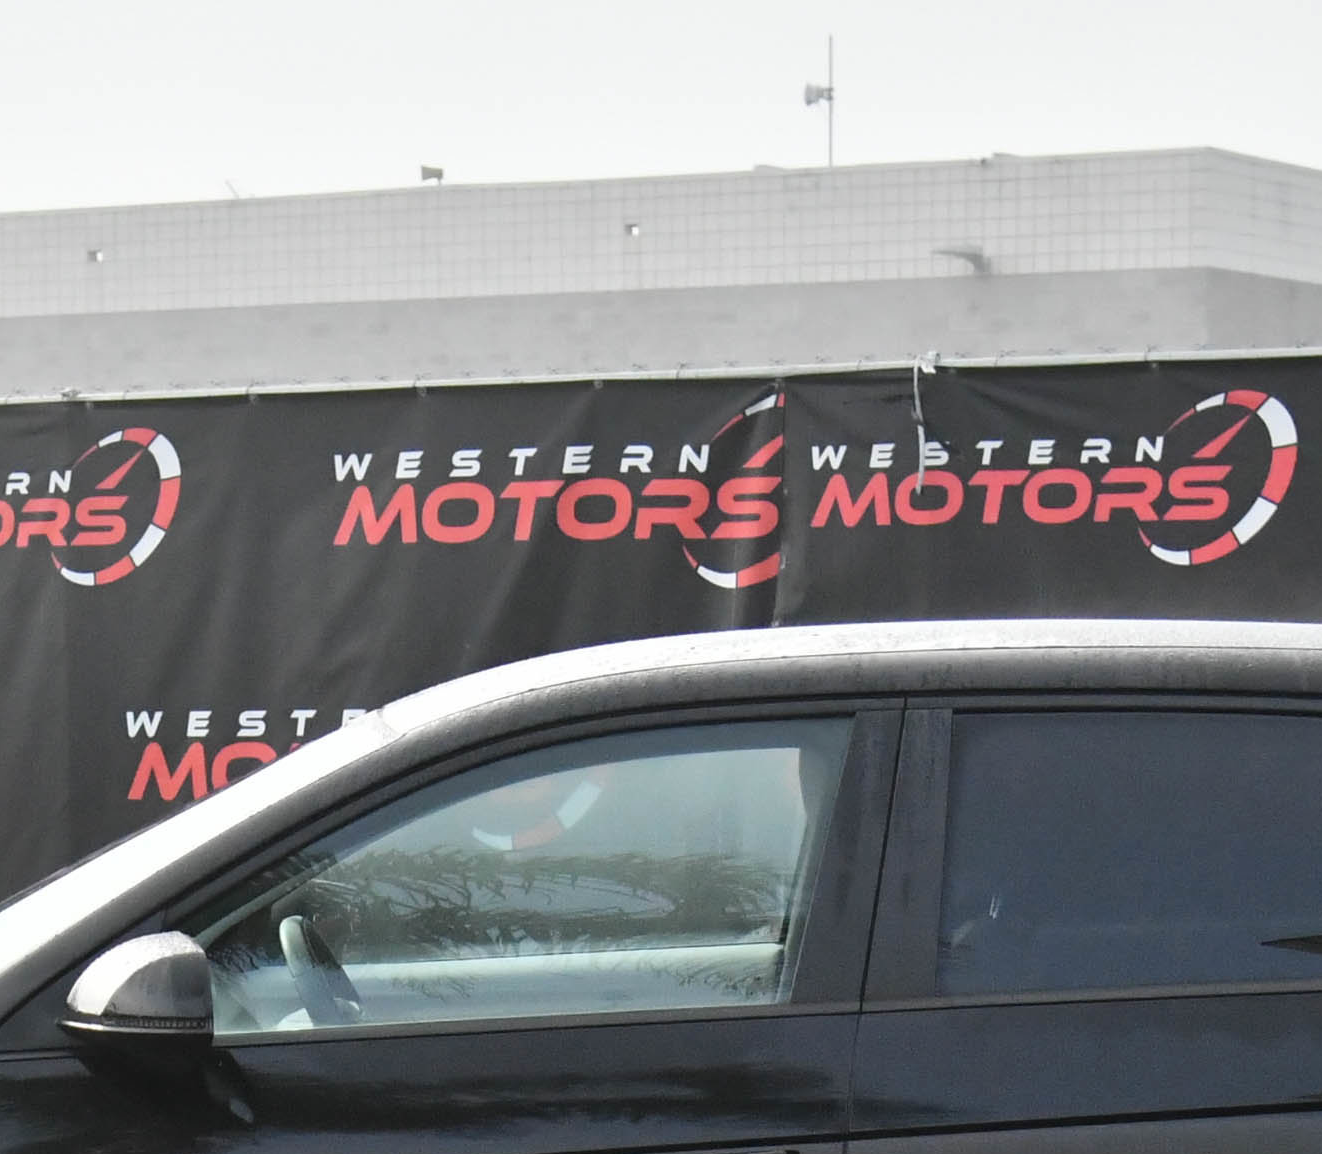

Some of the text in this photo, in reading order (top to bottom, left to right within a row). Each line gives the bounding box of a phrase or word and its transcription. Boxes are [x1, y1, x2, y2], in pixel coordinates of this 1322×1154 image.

[333, 443, 710, 482] WESTERN
[811, 435, 1165, 471] WESTERN
[333, 476, 783, 546] MOTORS
[810, 464, 1233, 529] MOTORS
